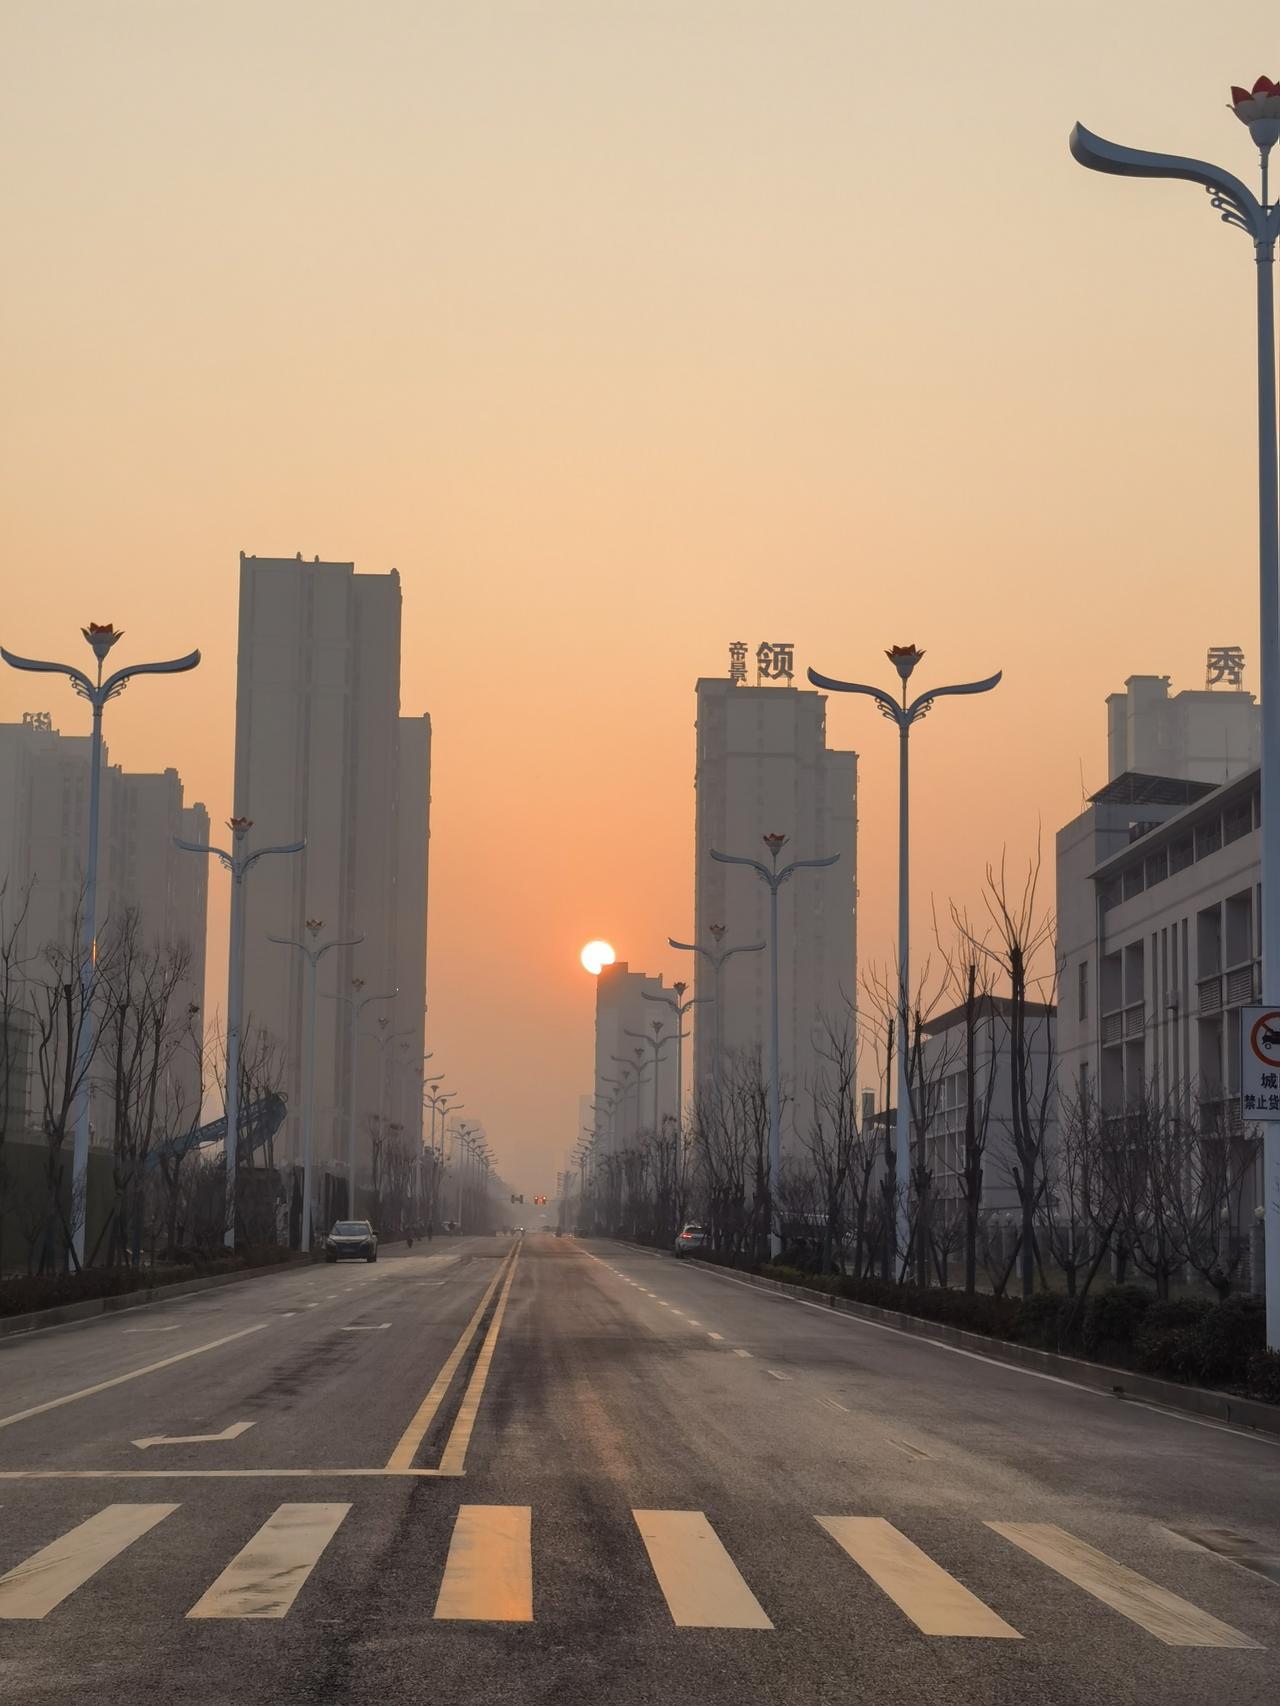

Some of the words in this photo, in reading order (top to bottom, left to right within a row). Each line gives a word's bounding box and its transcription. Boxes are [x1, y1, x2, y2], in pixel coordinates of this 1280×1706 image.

[756, 641, 794, 680] 领
[1206, 646, 1246, 685] 秀
[1260, 1072, 1280, 1089] 城
